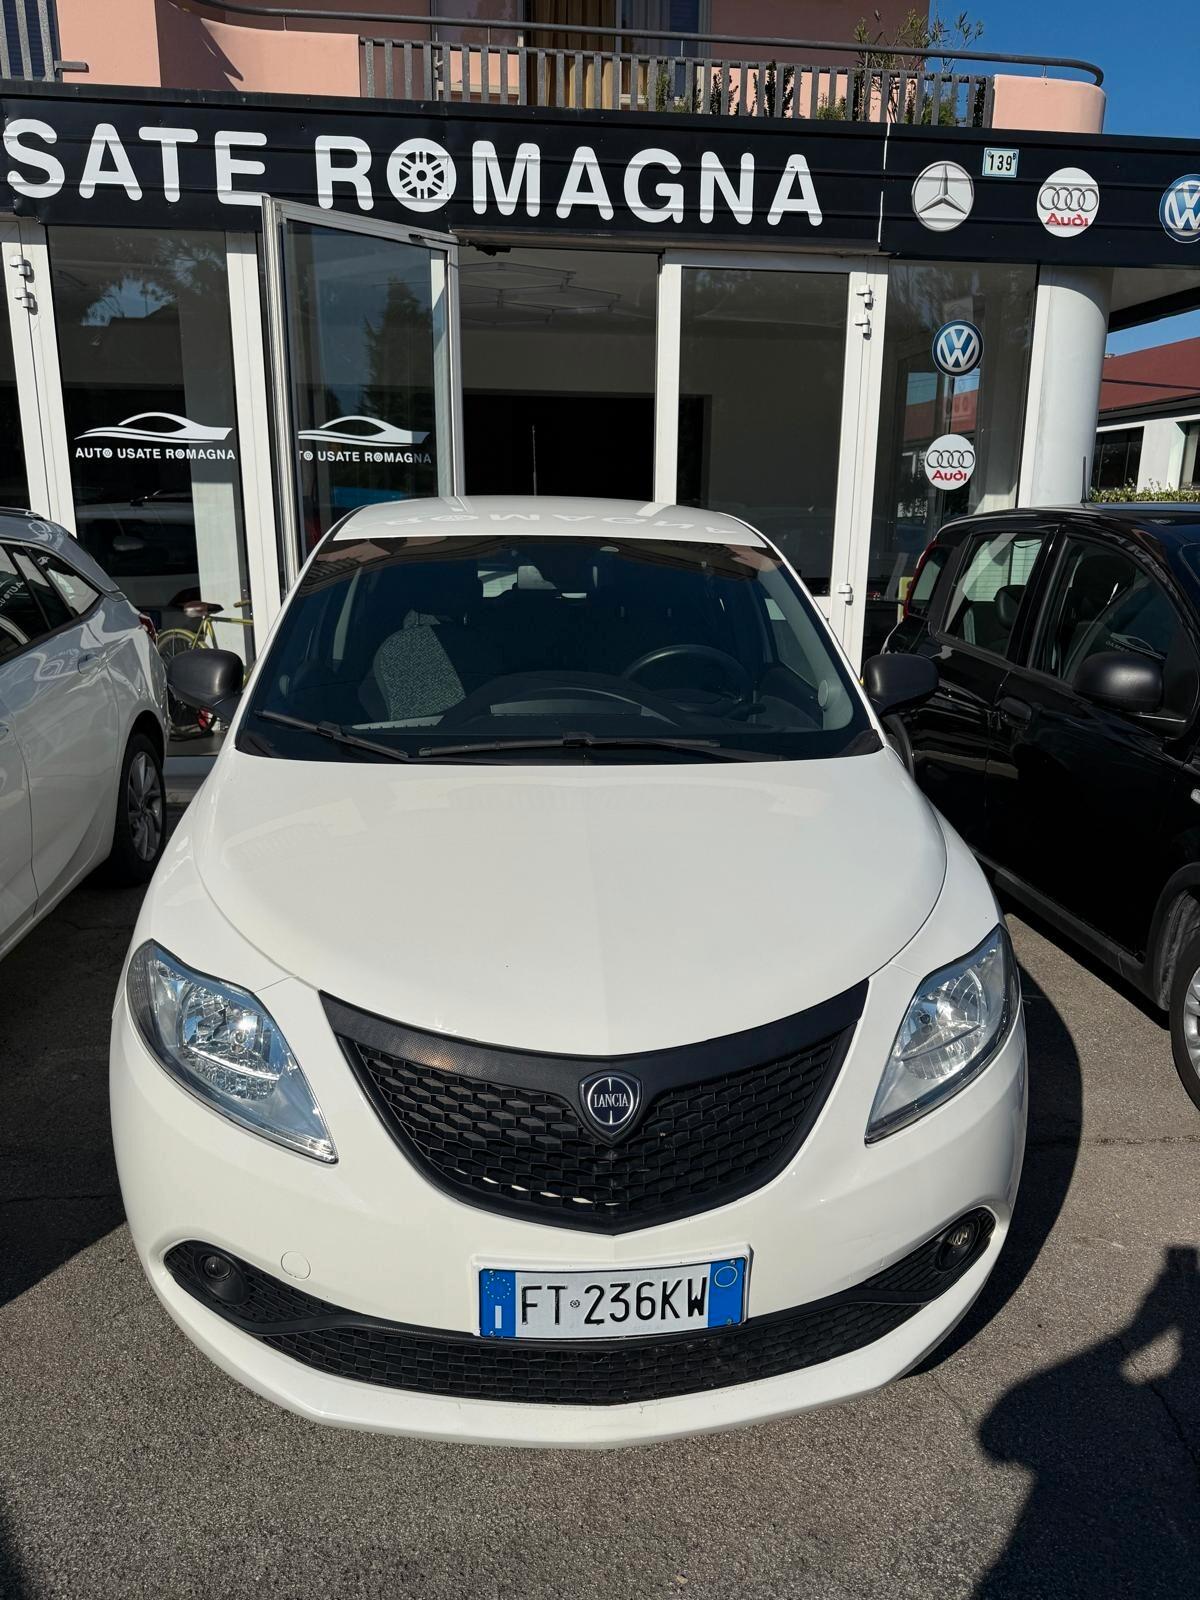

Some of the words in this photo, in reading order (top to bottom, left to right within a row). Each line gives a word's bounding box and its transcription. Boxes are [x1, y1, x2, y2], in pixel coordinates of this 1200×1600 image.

[3, 118, 270, 207] SATE
[315, 134, 823, 227] ROMAGNA
[1045, 212, 1089, 226] Audi
[75, 447, 113, 459] AUTO
[117, 448, 162, 460] USATE
[166, 448, 236, 460] ROMAGNA
[318, 451, 361, 462] USATE
[365, 452, 432, 464] ROMAGNA
[931, 470, 968, 482] Audi
[593, 1092, 629, 1108] LANCIA
[520, 1285, 568, 1326] FT
[583, 1275, 708, 1326] 236KW
